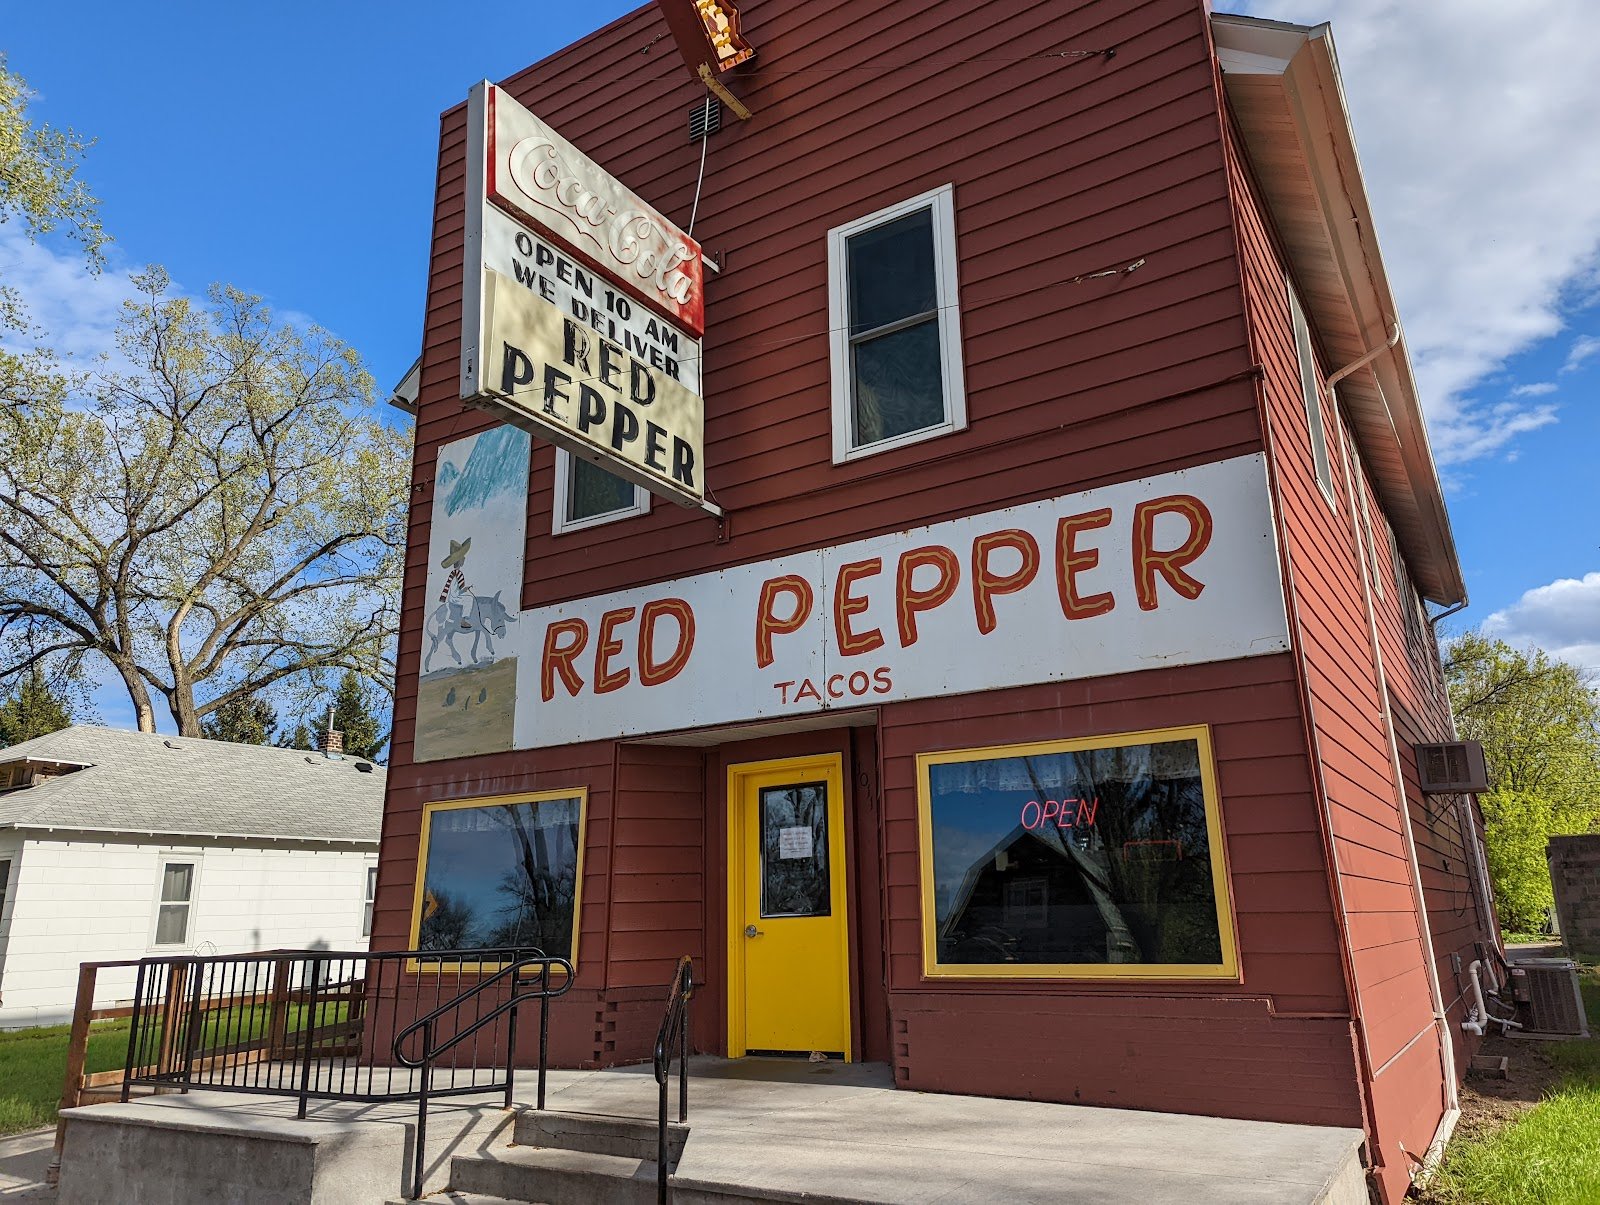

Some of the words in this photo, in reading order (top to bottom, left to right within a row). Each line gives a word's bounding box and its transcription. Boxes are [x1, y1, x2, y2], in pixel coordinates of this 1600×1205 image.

[508, 136, 697, 304] Coca-Cola
[512, 257, 556, 305] WE
[571, 296, 680, 383] DELIVER
[514, 231, 594, 299] OPEN
[604, 290, 632, 322] 10
[644, 315, 678, 354] AM
[501, 341, 696, 488] PEPPER
[563, 317, 656, 408] RED
[541, 597, 696, 703] RED
[755, 494, 1213, 670] PEPPER
[773, 666, 893, 705] TACOS
[1021, 797, 1099, 829] OPEN
